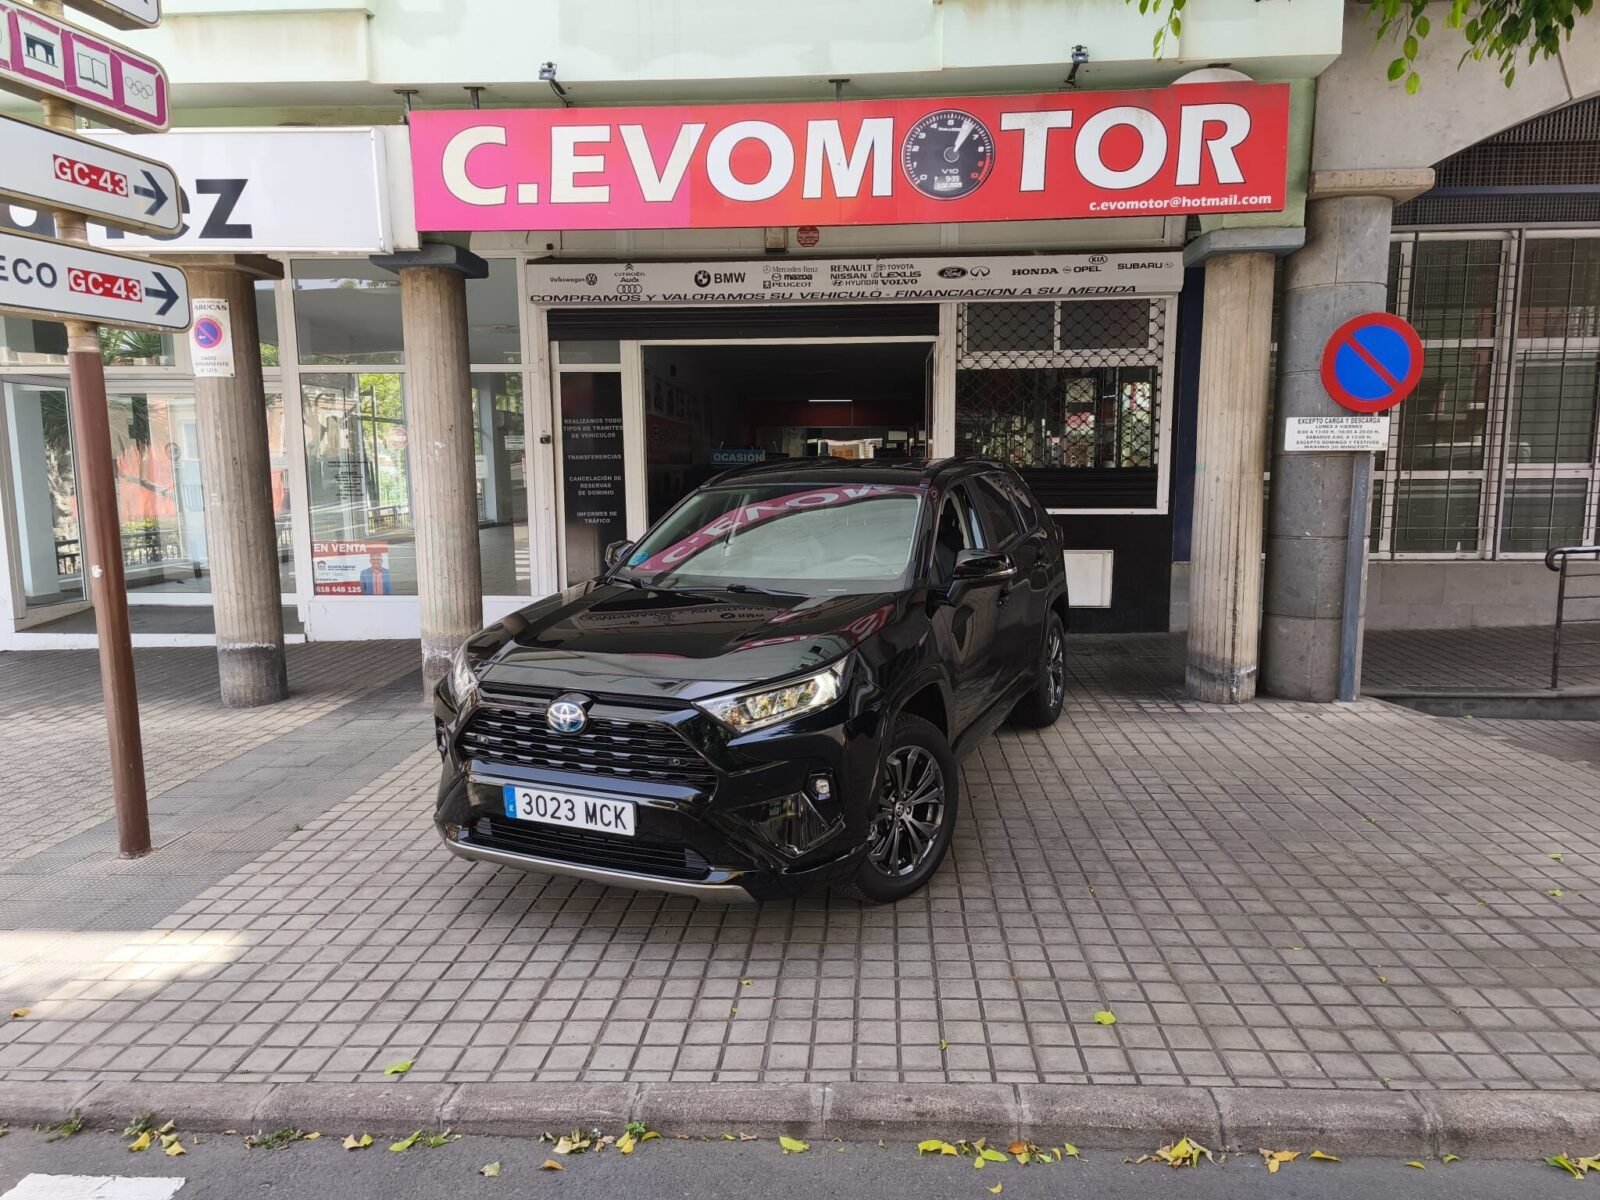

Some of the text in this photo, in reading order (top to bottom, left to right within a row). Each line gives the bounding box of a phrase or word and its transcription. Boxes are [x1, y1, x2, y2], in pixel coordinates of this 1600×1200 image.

[54, 157, 129, 196] GC-43
[1089, 194, 1272, 211] c.evomotor@hotmail.com
[1090, 256, 1106, 264] KIA
[772, 265, 819, 273] Mercedes-Benz
[830, 264, 873, 273] RENAULT
[887, 263, 915, 271] TOYOTA
[1073, 265, 1102, 274] OPEL
[1117, 262, 1163, 270] SUBARU
[830, 272, 868, 280] NISSAN
[879, 270, 922, 279] LEXUS
[1011, 267, 1060, 276] HONDA
[714, 272, 746, 284] BMW
[783, 273, 813, 281] mazda
[69, 270, 142, 302] GC-43
[844, 279, 879, 287] HYUNDAI
[881, 278, 918, 286] VOLVO
[530, 294, 641, 303] COMPRAMOS
[646, 294, 657, 302] Y
[662, 292, 766, 302] VALORAMOS
[769, 292, 794, 300] SU
[799, 290, 882, 300] VEHICULO
[894, 287, 1018, 298] FINANCIACION
[1020, 287, 1033, 296] A
[1037, 286, 1064, 295] SU
[1068, 285, 1137, 294] MEDIDA
[568, 453, 622, 461] TRANSFERENCIAS
[313, 543, 367, 553] EN VENTA
[522, 792, 576, 822] 3023
[585, 801, 627, 830] MCK
